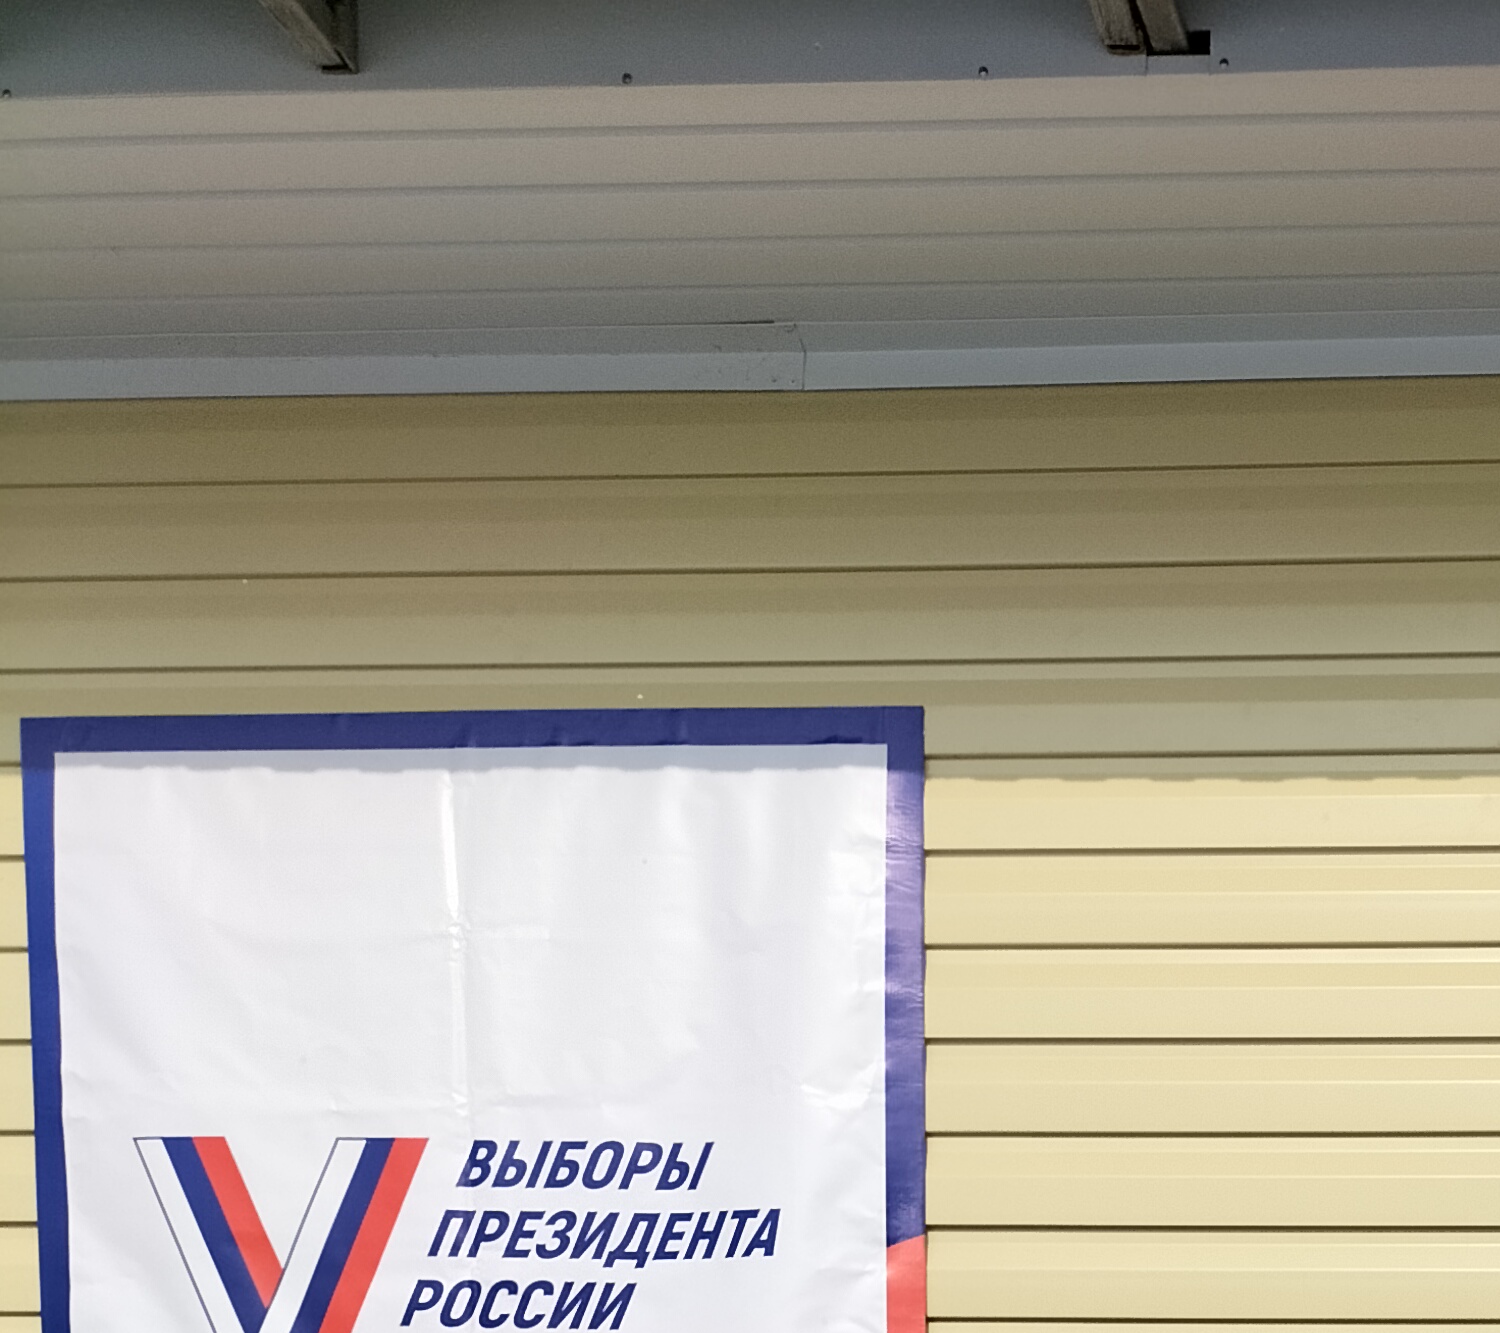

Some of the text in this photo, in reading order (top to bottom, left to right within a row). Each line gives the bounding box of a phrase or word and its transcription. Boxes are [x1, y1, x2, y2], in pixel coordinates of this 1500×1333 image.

[455, 1139, 715, 1191] ВЫБОРЫ
[427, 1208, 781, 1269] ПРЕЗИДЕНТА
[400, 1279, 637, 1331] РОССИИ
